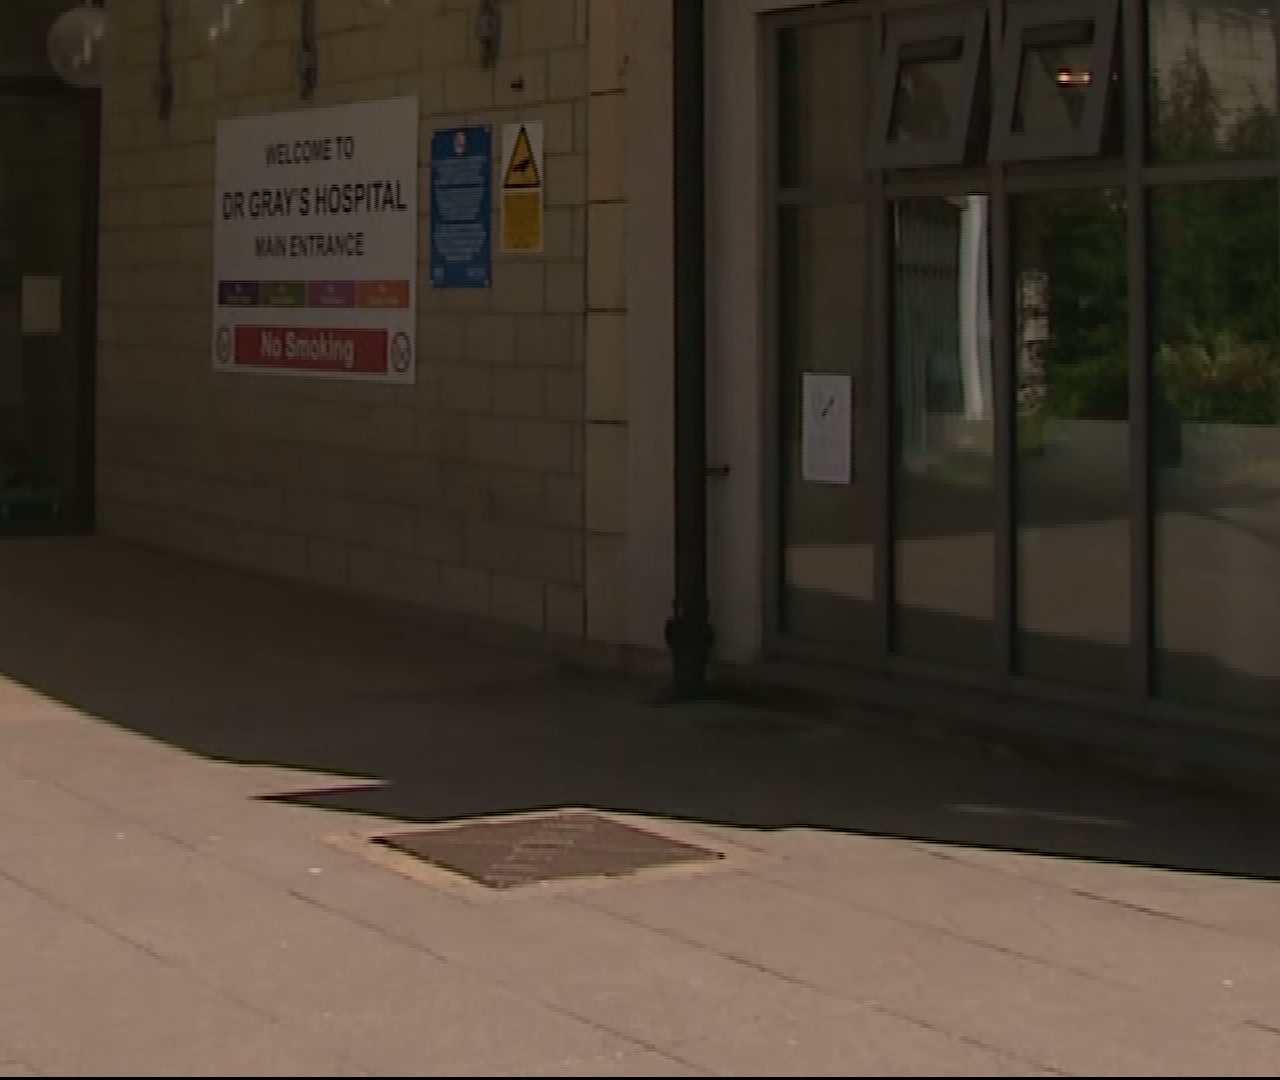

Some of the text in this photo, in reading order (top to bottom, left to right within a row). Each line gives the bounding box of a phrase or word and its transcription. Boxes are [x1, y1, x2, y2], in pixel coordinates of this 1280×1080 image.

[265, 135, 355, 167] WELCOME TO
[222, 180, 408, 220] DR GRAY'S HOSPITAL
[255, 232, 365, 258] MAIN ENTRANCE
[260, 331, 355, 369] No Smoking
